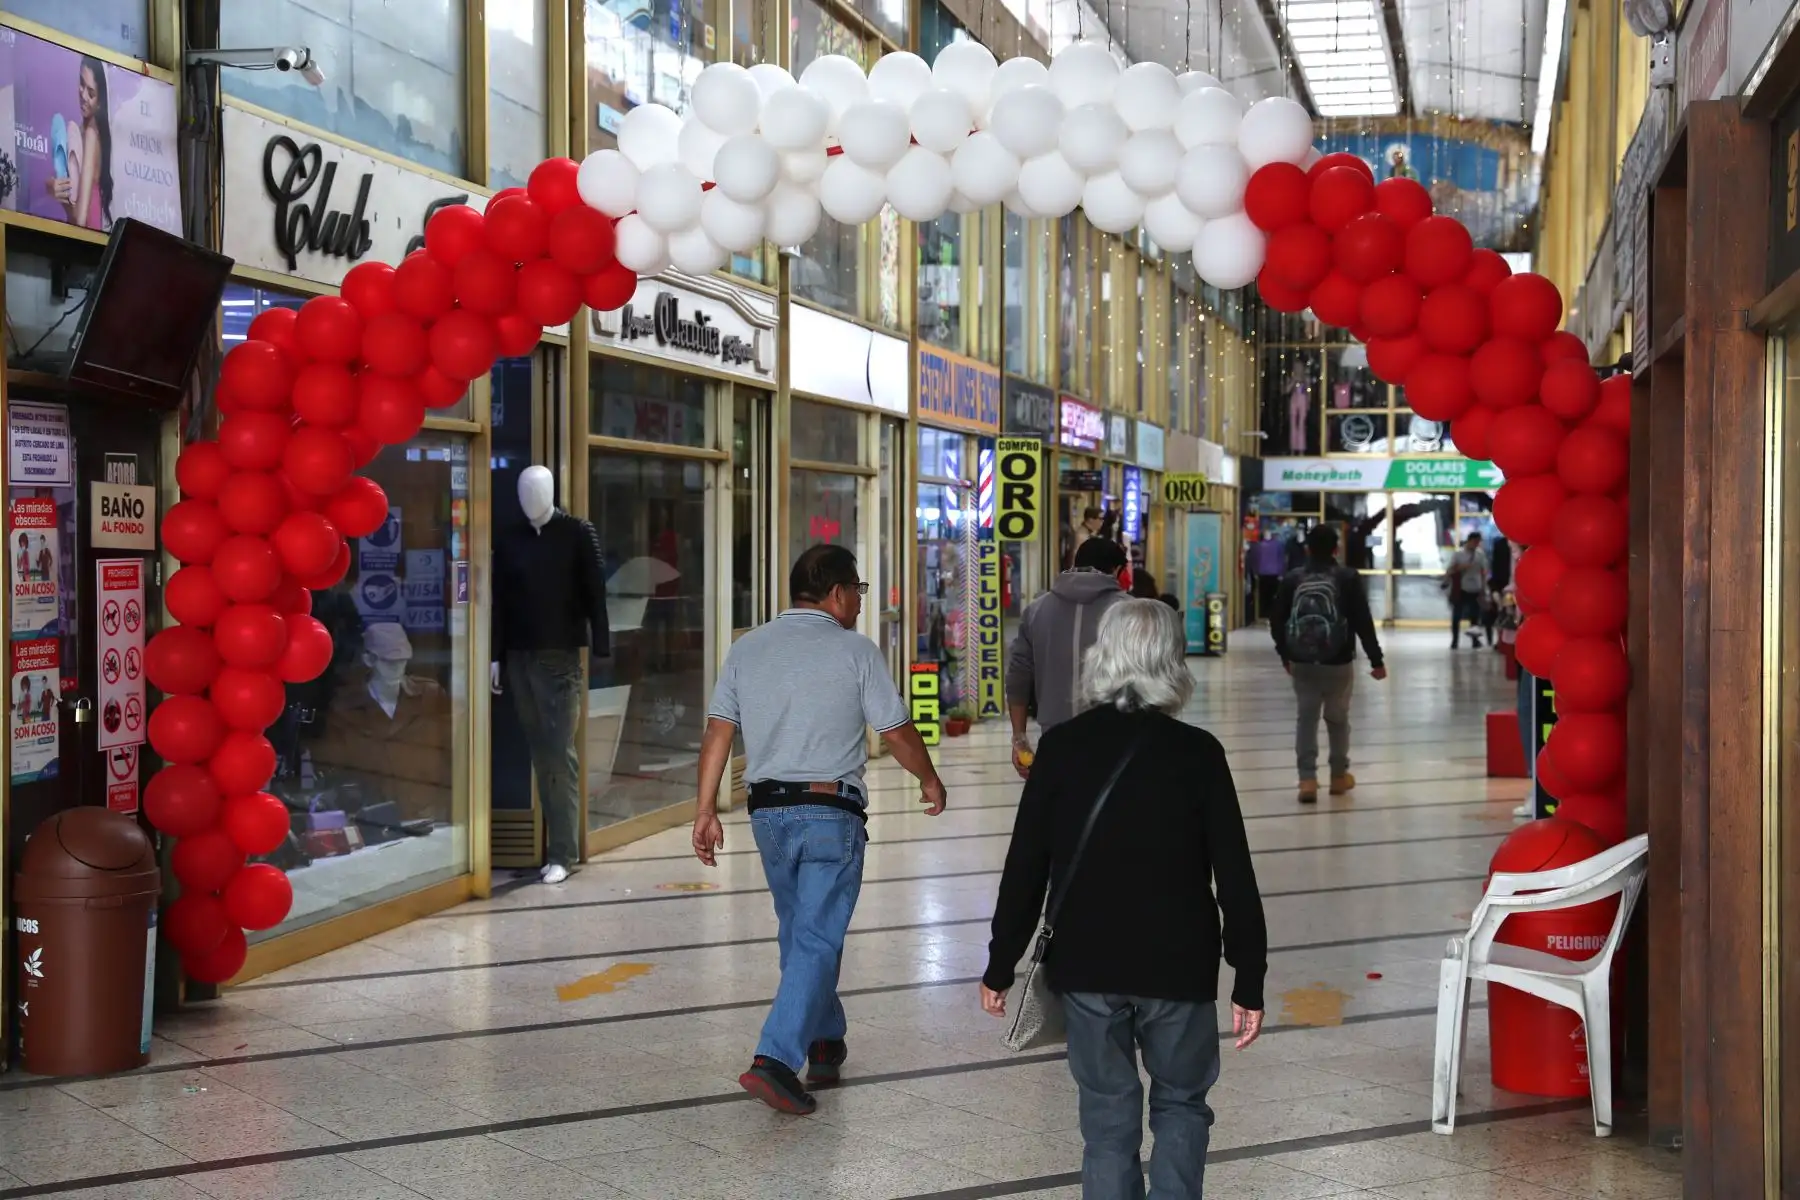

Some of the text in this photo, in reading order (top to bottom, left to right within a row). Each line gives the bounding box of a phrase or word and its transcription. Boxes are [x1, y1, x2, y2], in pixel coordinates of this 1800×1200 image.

[129, 131, 163, 156] MEJOR
[124, 160, 173, 187] CALZADO
[263, 134, 373, 270] Club
[998, 440, 1039, 452] COMPRO
[107, 462, 136, 485] AFORO
[1281, 466, 1362, 483] MoneyRuth
[1405, 461, 1467, 473] DOLARES
[1420, 474, 1465, 487] EUROS
[998, 453, 1037, 540] ORO
[1165, 480, 1205, 501] ORO
[13, 502, 52, 513] Las miradas
[101, 492, 144, 519] BAÑO
[102, 521, 144, 534] AL FONDO
[15, 582, 55, 596] SON ACOSO
[409, 584, 440, 597] VISA
[408, 611, 442, 623] VISA
[979, 545, 1000, 714] PELUQUERIA
[16, 642, 55, 656] Las miradas
[912, 674, 939, 744] ORO
[14, 722, 55, 739] SON ACOSO
